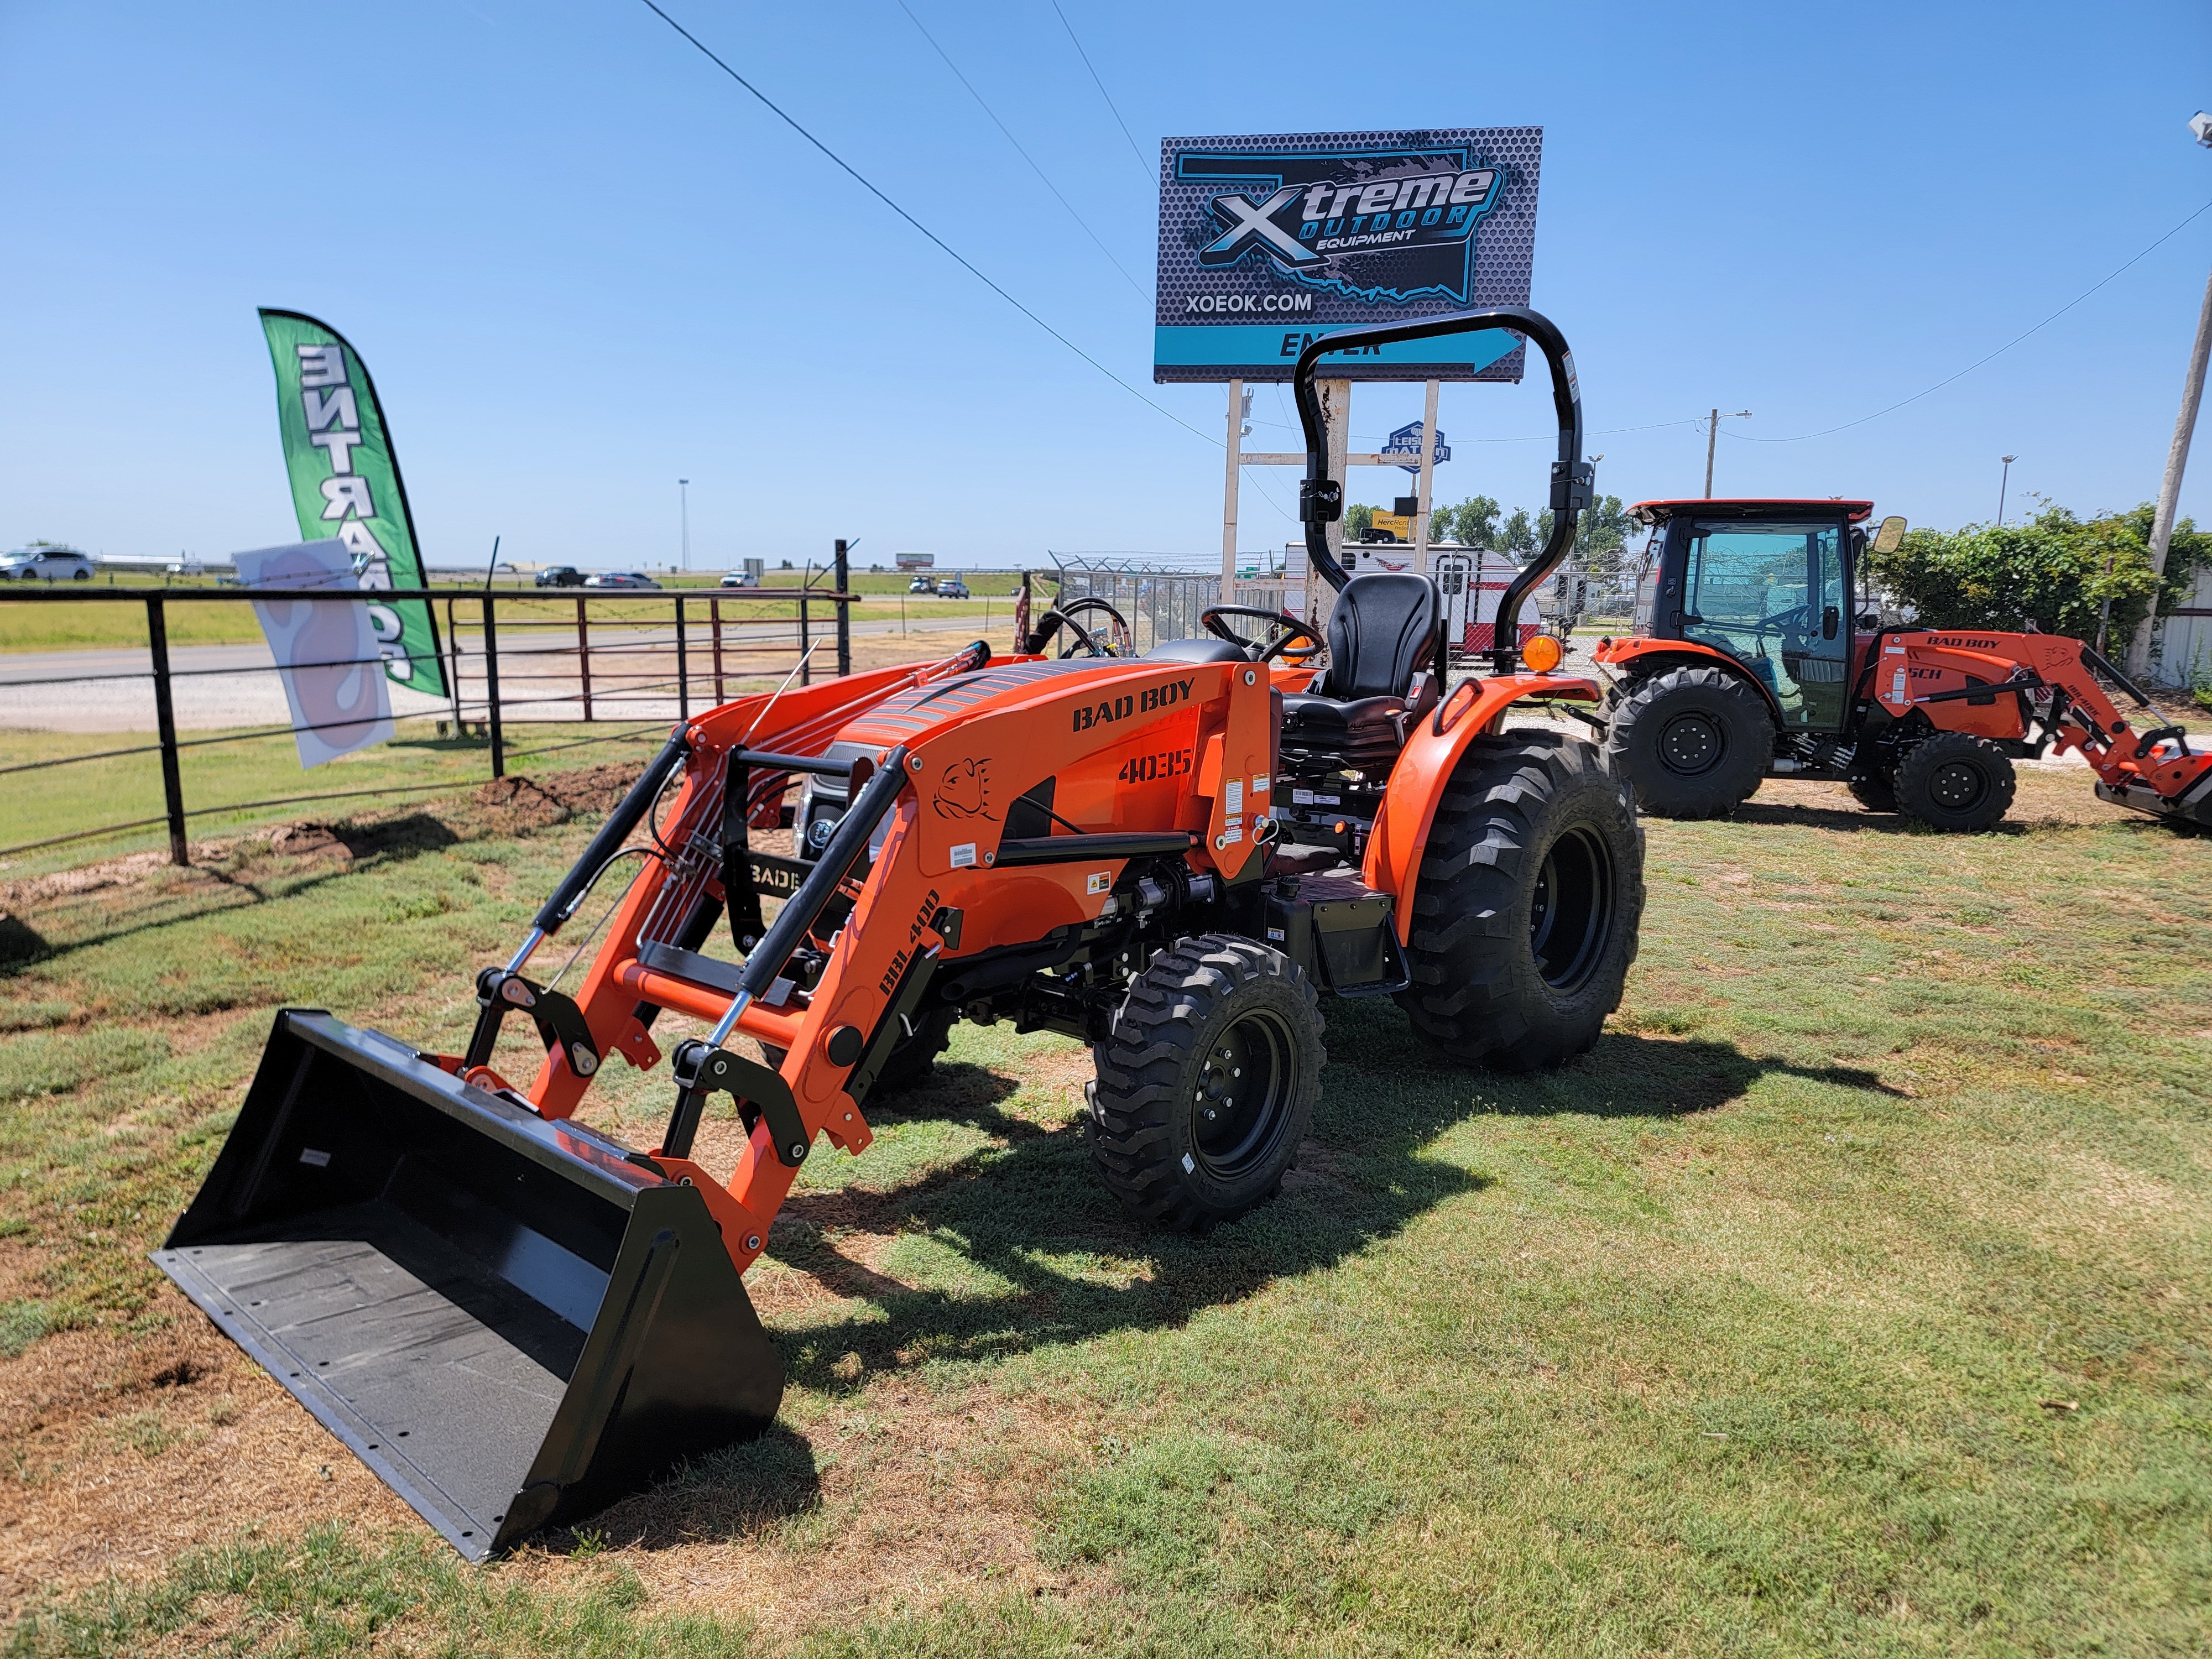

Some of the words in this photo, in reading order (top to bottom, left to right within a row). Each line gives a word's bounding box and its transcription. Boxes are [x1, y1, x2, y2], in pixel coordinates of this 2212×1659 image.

[1204, 171, 1494, 260] Xtreme
[1299, 206, 1468, 239] OUTDOOR
[1316, 229, 1416, 251] EQUIPMENT
[1185, 294, 1312, 312] XOEOK.COM
[1927, 637, 1963, 646] BAD
[1965, 639, 2001, 649] BOY
[1073, 695, 1133, 733] BAD
[1140, 676, 1196, 713] BOY
[1118, 748, 1191, 784] 4035
[879, 948, 912, 996] BBL
[909, 889, 940, 945] 400
